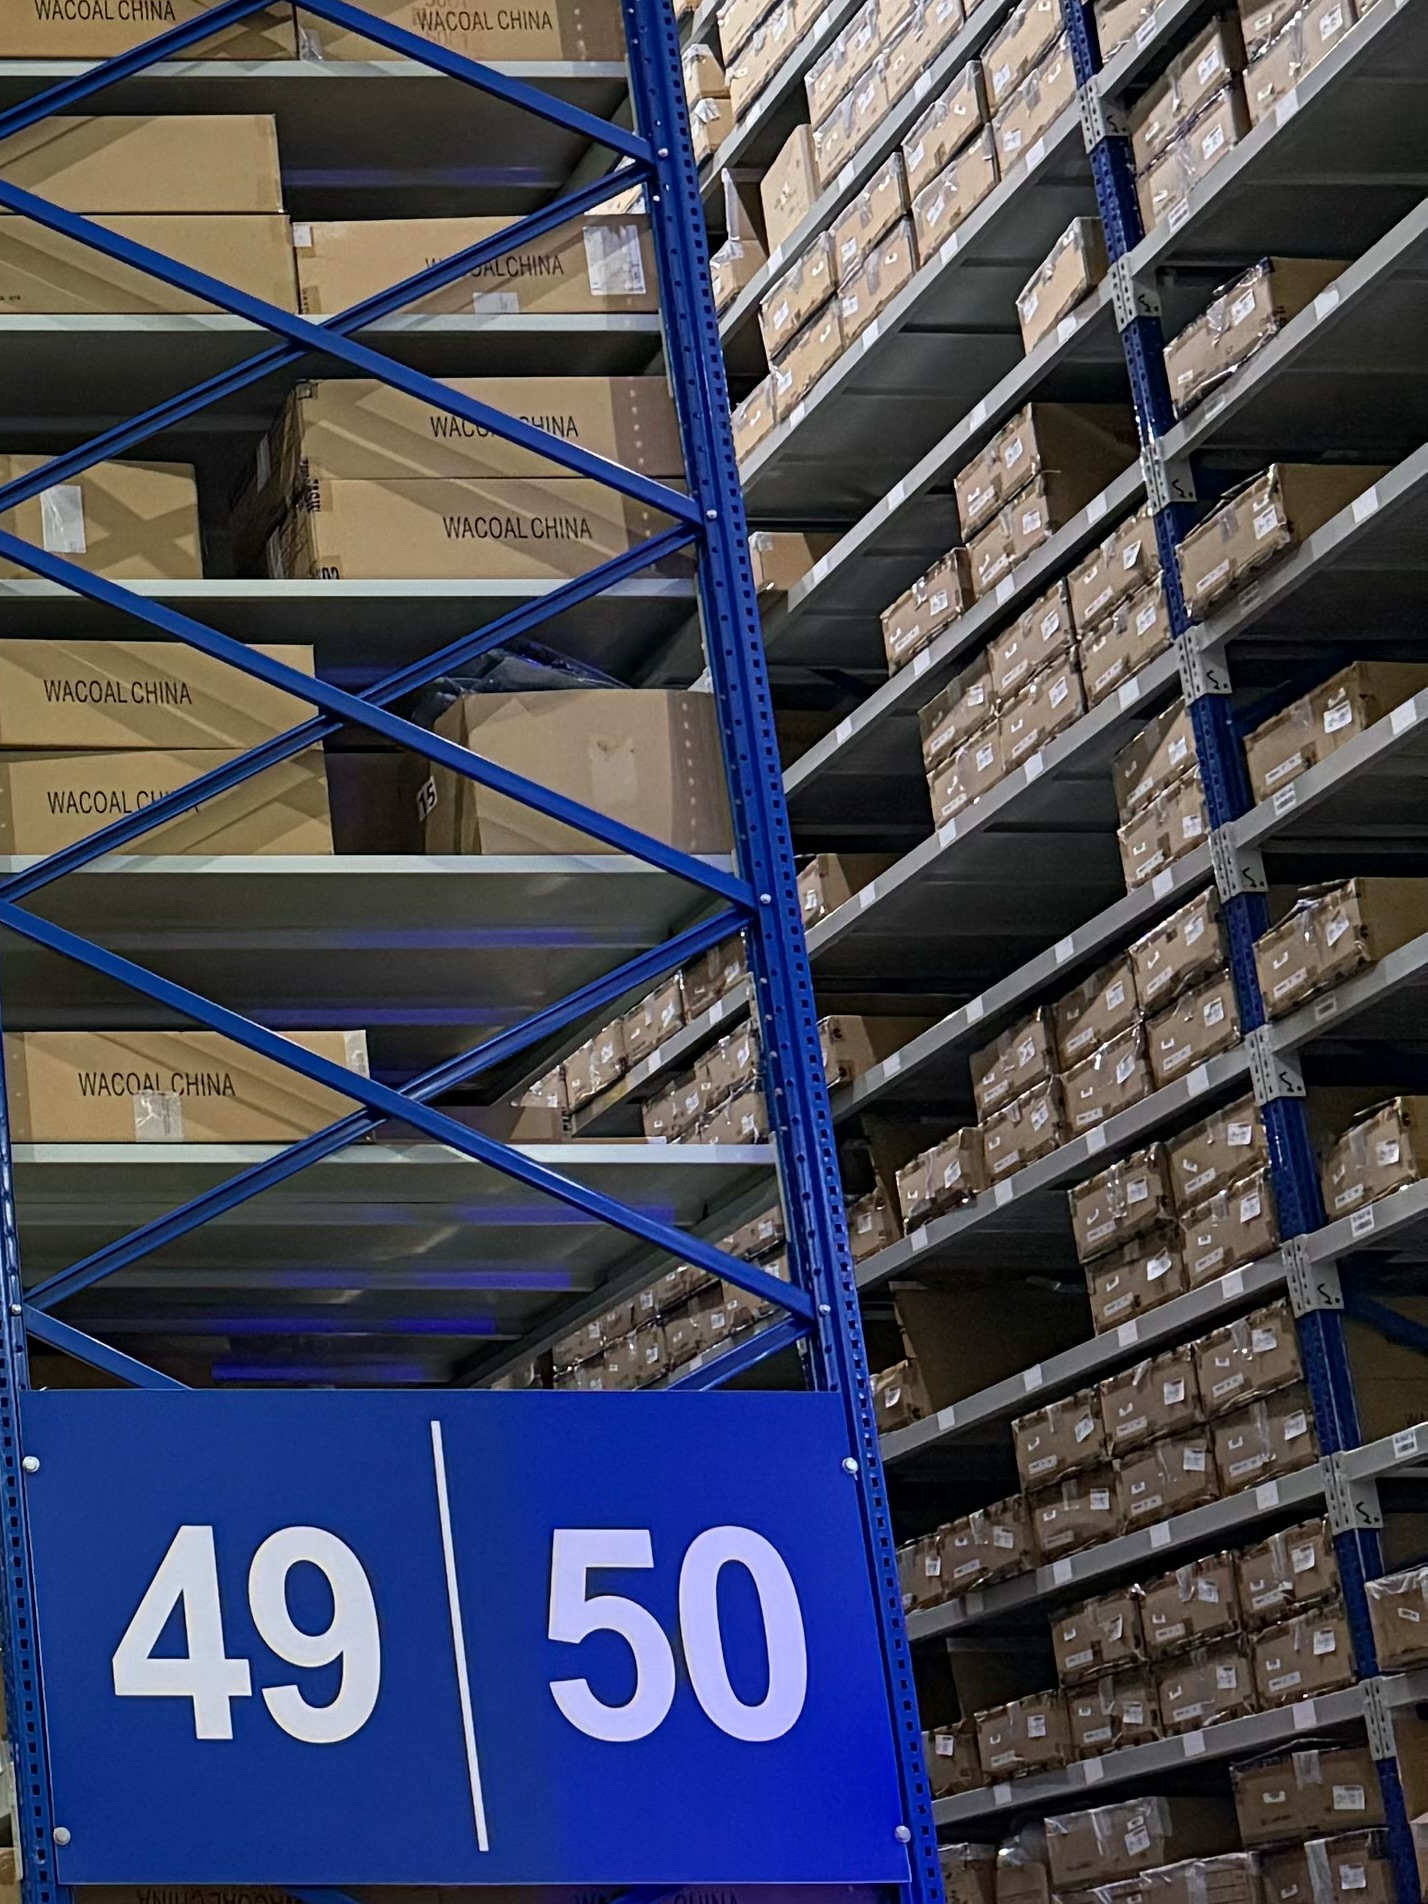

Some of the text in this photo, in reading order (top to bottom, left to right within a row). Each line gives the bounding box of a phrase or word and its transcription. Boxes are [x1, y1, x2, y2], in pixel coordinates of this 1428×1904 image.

[35, 0, 175, 22] WACOAL CHINA
[416, 8, 553, 31] WACOAL CHINA
[506, 256, 563, 278] CHINA
[443, 515, 592, 540] WACOAL CHINA
[44, 679, 191, 706] WACOAL CHINA
[48, 791, 132, 814] WACOAL
[170, 1073, 235, 1097] CHINA
[111, 1525, 381, 1744] 49
[548, 1525, 808, 1743] 50
